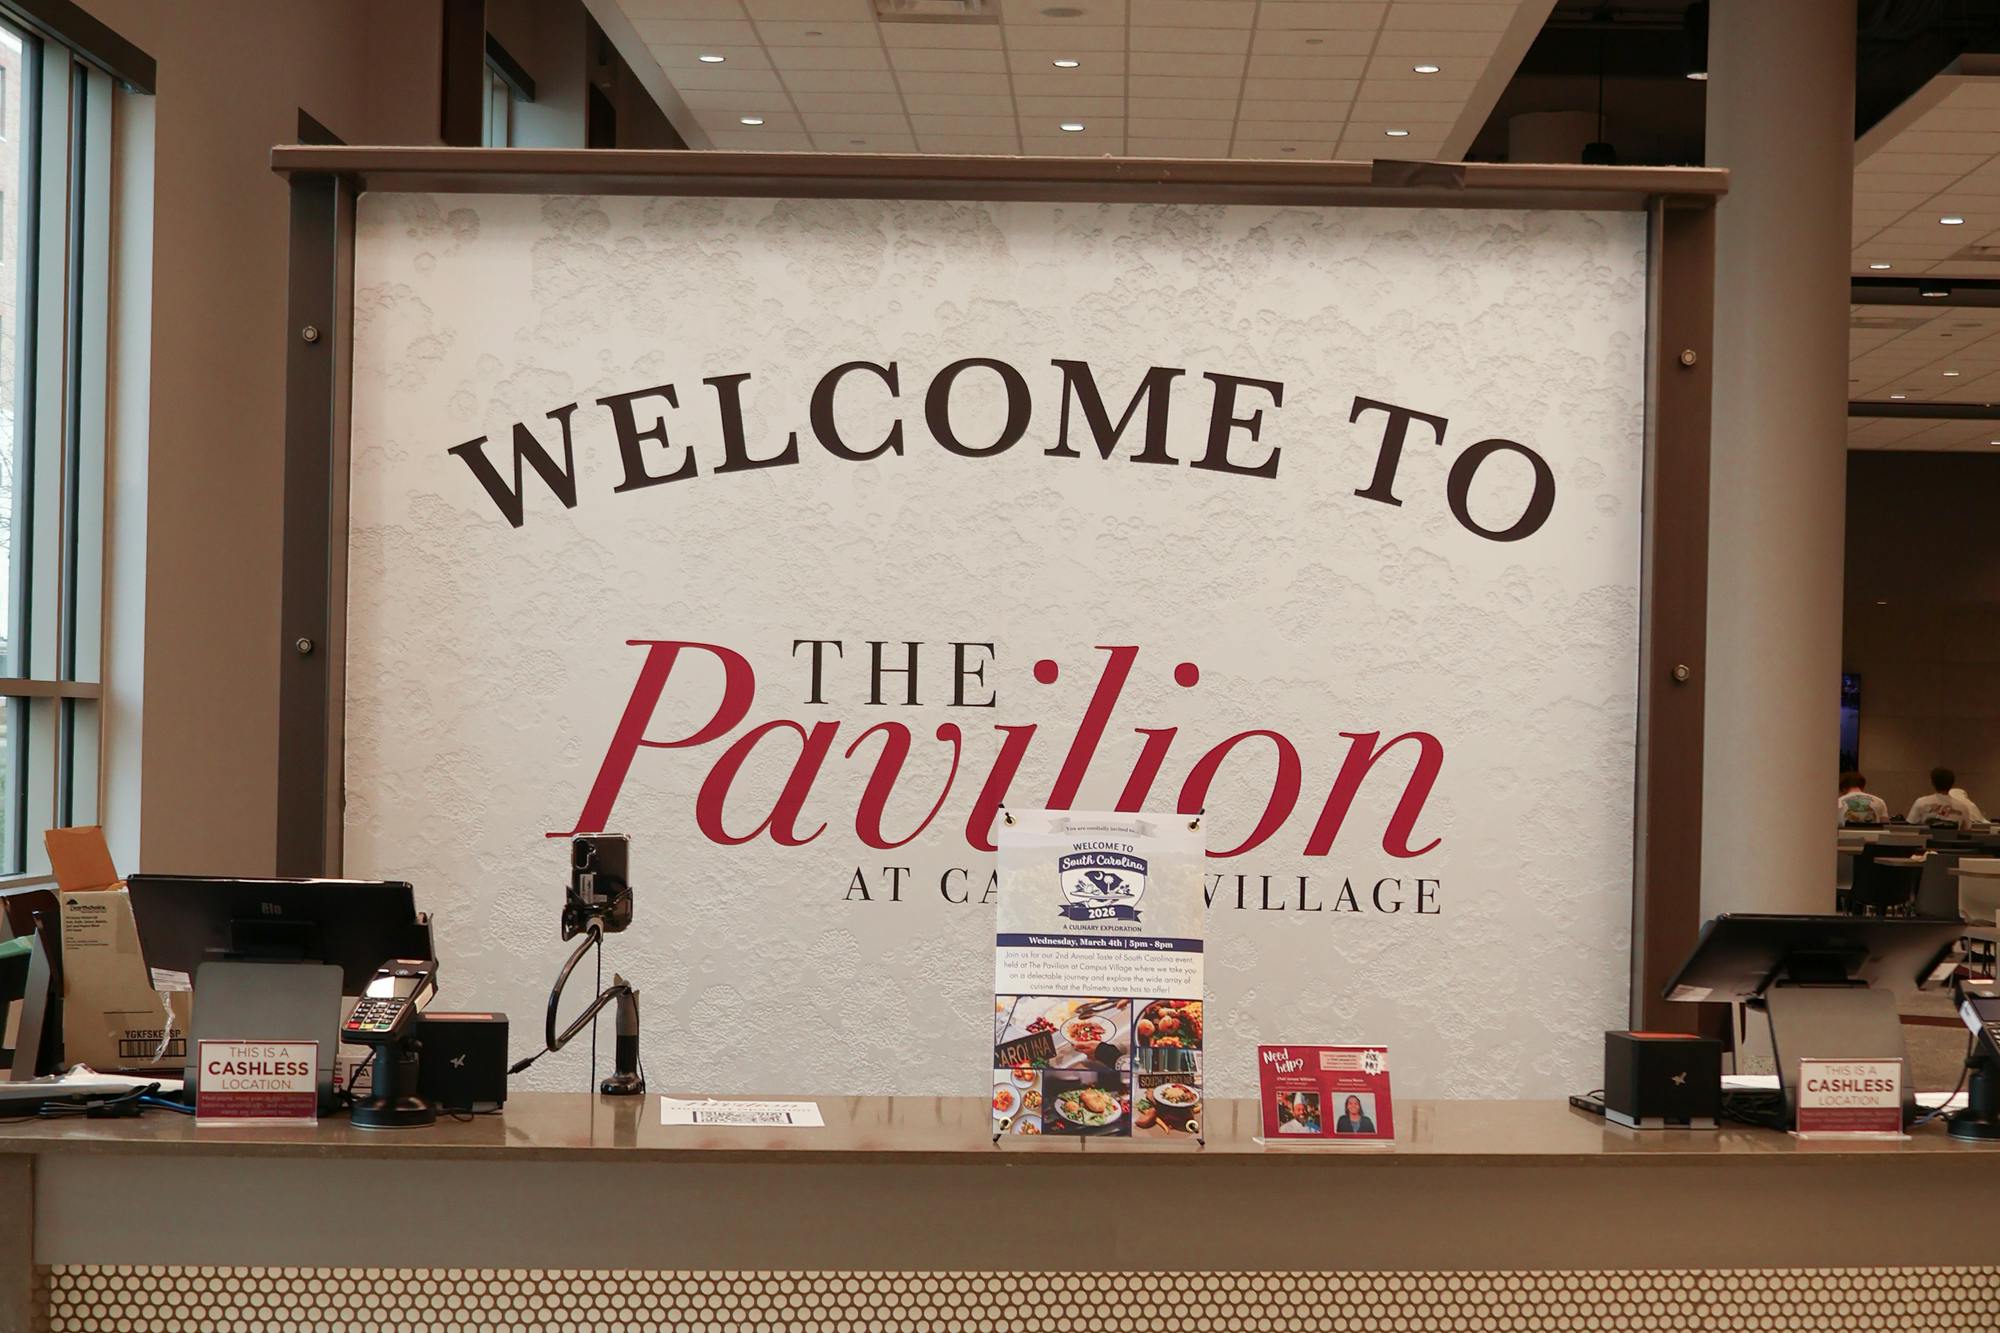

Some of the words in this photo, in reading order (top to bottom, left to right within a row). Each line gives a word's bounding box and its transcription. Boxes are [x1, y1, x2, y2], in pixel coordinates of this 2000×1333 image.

[447, 357, 1284, 529] WELCOME
[1348, 395, 1556, 543] TO
[792, 639, 997, 708] THE
[545, 639, 1444, 858] Pavilion
[1073, 841, 1119, 851] WELCOME
[1122, 844, 1134, 853] TO
[1062, 854, 1095, 870] South
[1096, 854, 1145, 871] Carolina
[845, 866, 911, 902] AT
[1203, 873, 1442, 915] VILLAGE
[1088, 907, 1116, 919] 2026
[1028, 936, 1078, 947] Wednesday,
[1080, 938, 1107, 947] March
[1108, 939, 1122, 947] 4th
[1128, 940, 1148, 949] 5pm
[1154, 940, 1173, 950] 8pm
[1071, 952, 1095, 960] Annual
[125, 1030, 181, 1039] YGKFSKESP
[230, 1047, 259, 1058] THIS
[263, 1047, 275, 1058] IS
[280, 1047, 289, 1058] A
[1263, 1048, 1288, 1065] Need
[208, 1061, 309, 1076] CASHLESS
[1275, 1058, 1304, 1074] help?
[1825, 1065, 1851, 1076] THIS
[1855, 1065, 1865, 1076] IS
[1868, 1065, 1877, 1075] A
[1807, 1079, 1895, 1092] CASHLESS
